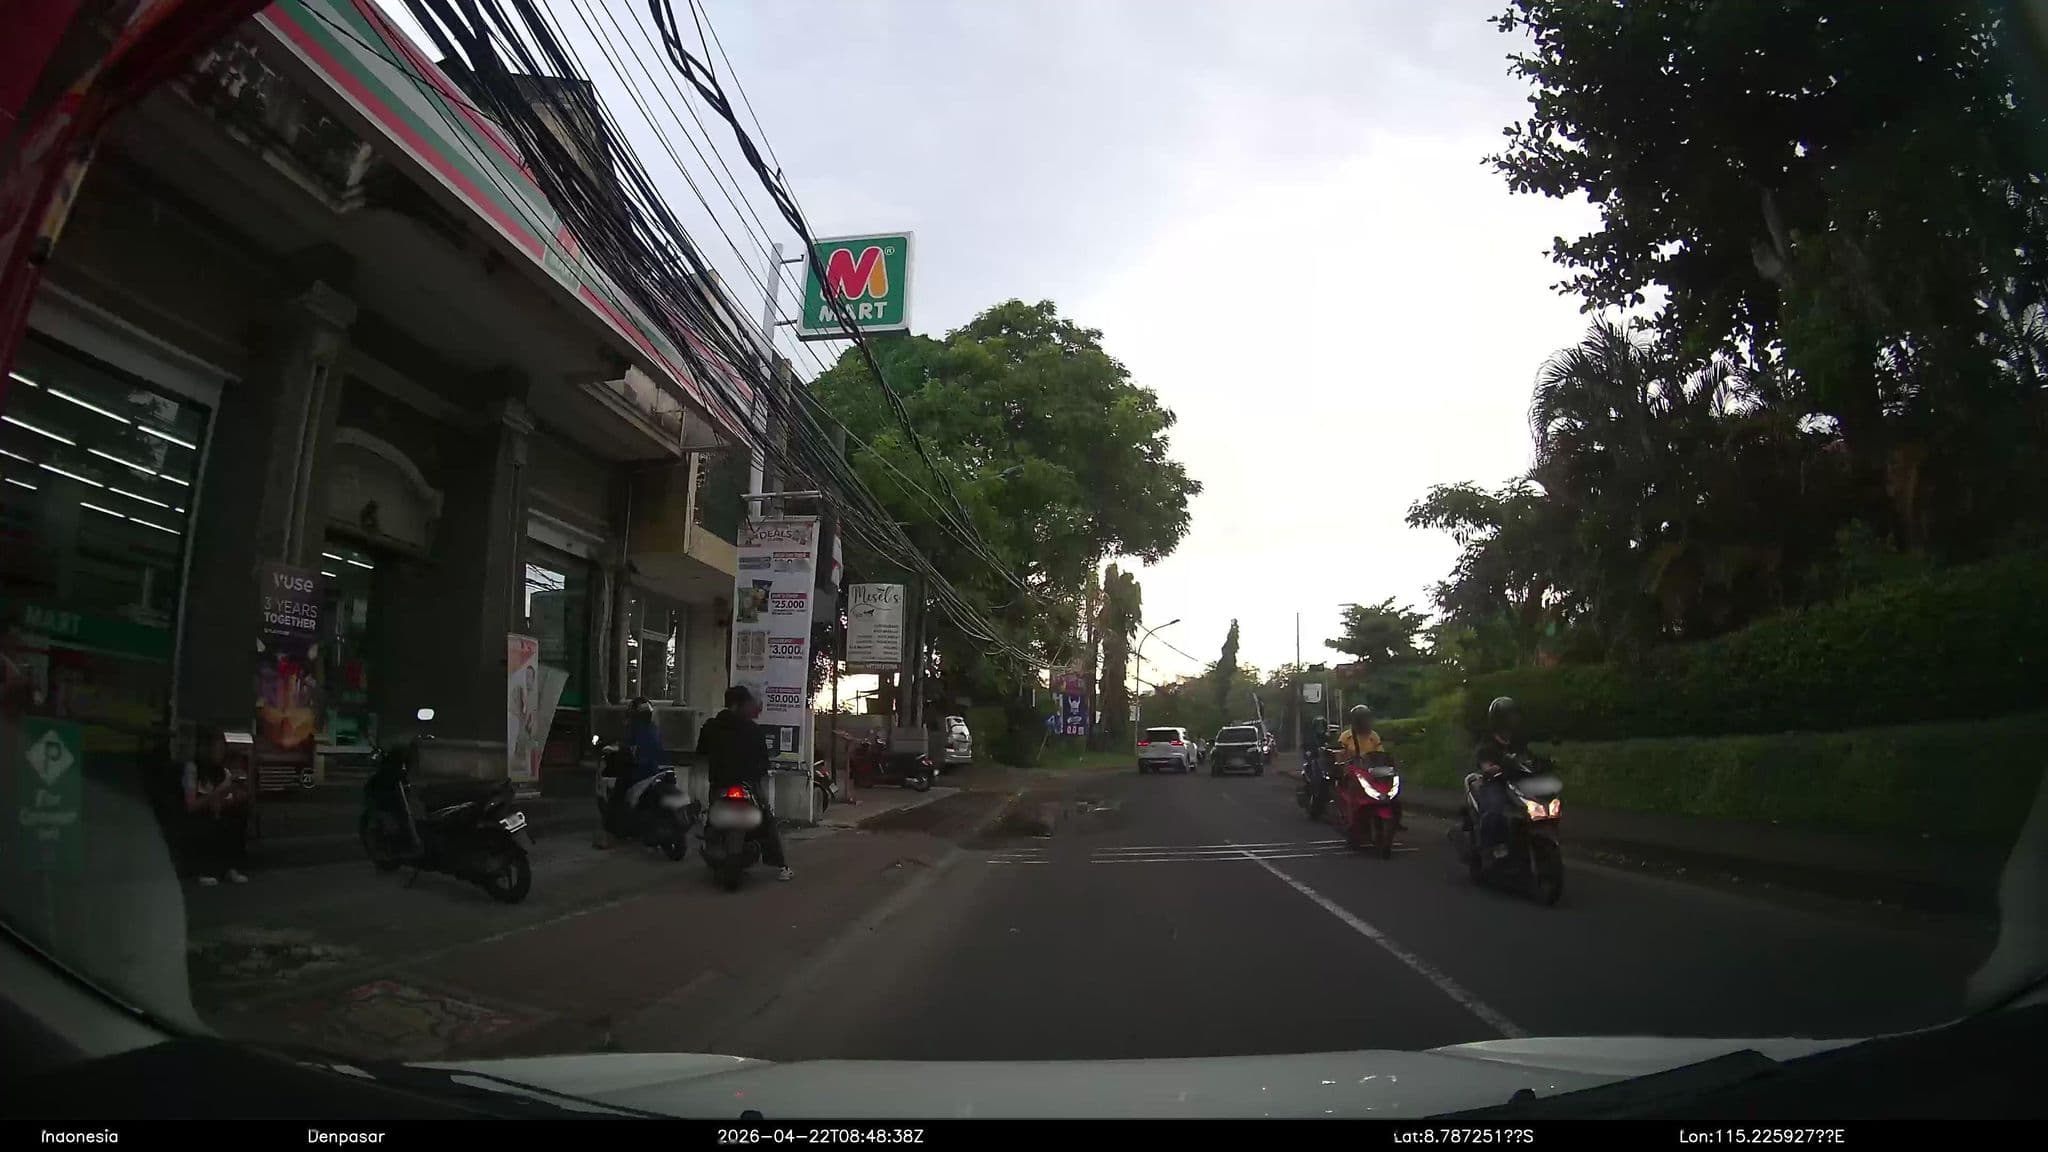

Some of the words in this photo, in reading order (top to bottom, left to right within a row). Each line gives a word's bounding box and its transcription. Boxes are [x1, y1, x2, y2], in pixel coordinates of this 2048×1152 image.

[819, 301, 888, 323] MART
[264, 596, 272, 610] 3
[277, 599, 319, 619] YEARS
[263, 611, 317, 631] TOGETHER
